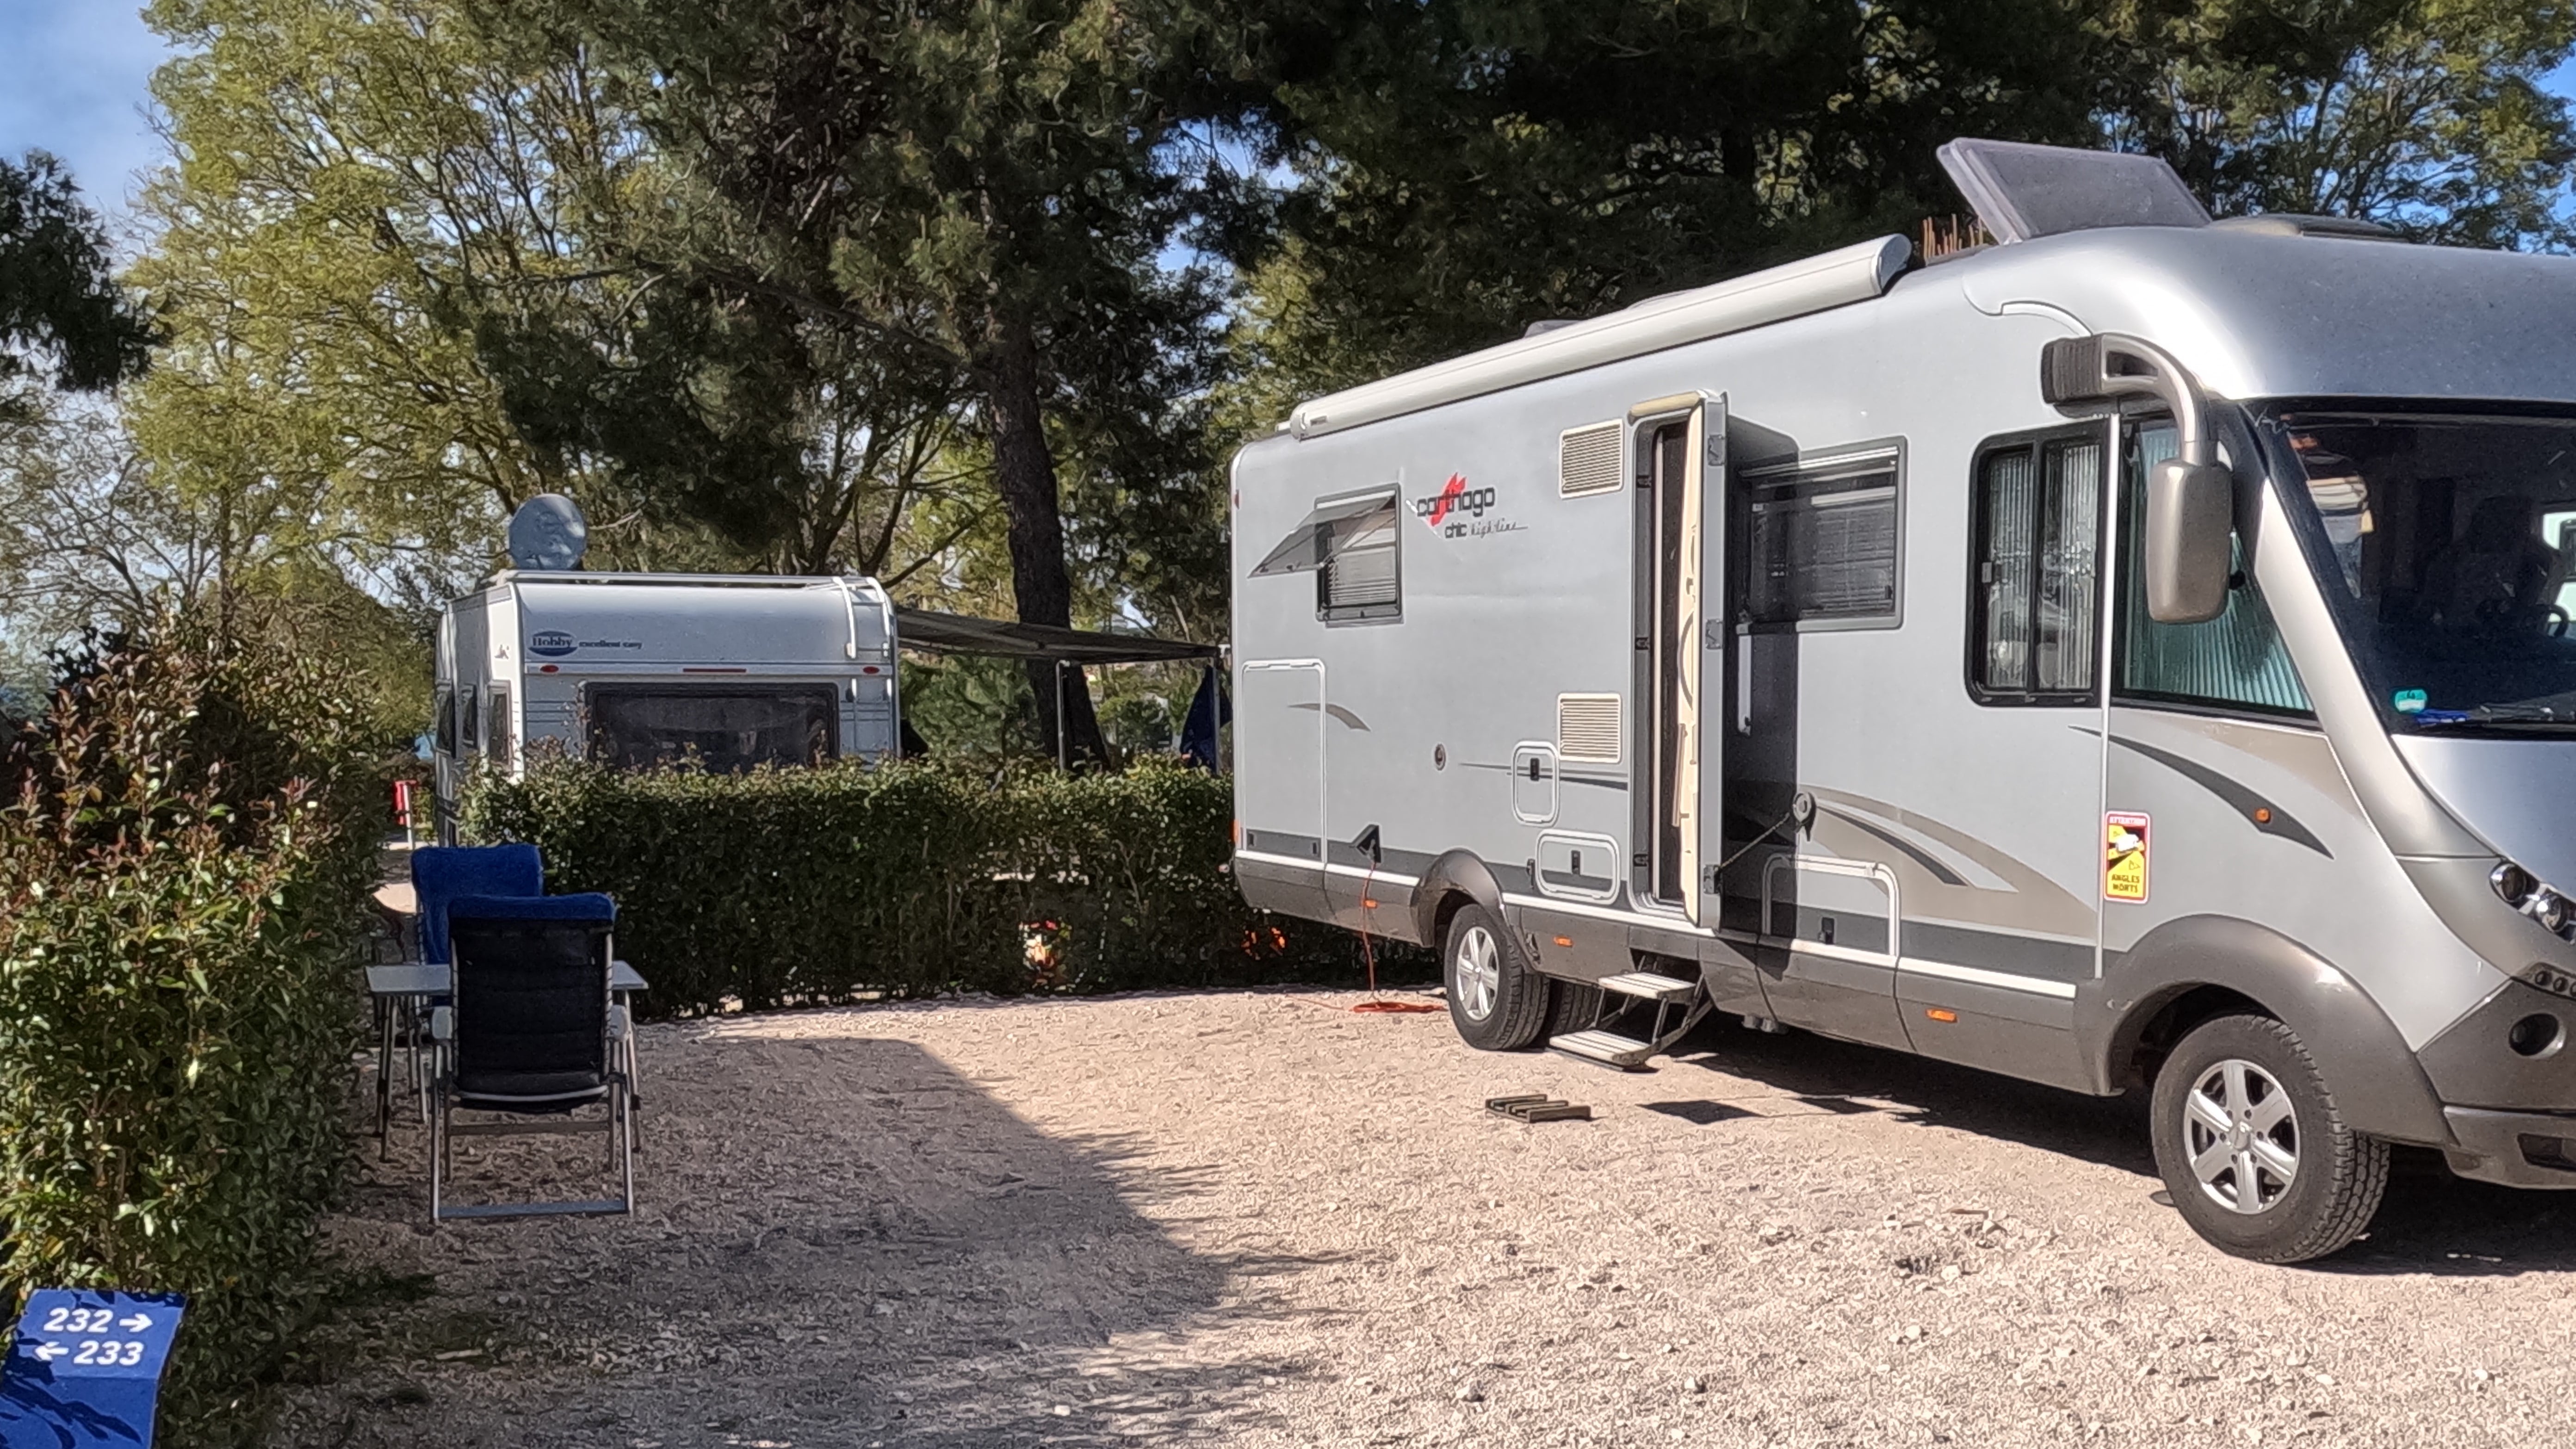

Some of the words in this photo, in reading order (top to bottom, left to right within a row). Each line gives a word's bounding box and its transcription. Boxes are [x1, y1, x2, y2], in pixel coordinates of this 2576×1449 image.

[1417, 487, 1495, 517] carthago
[533, 636, 573, 648] Hobby
[2112, 874, 2140, 883] ANGLES
[43, 1307, 113, 1333] 232
[73, 1340, 144, 1366] 233
